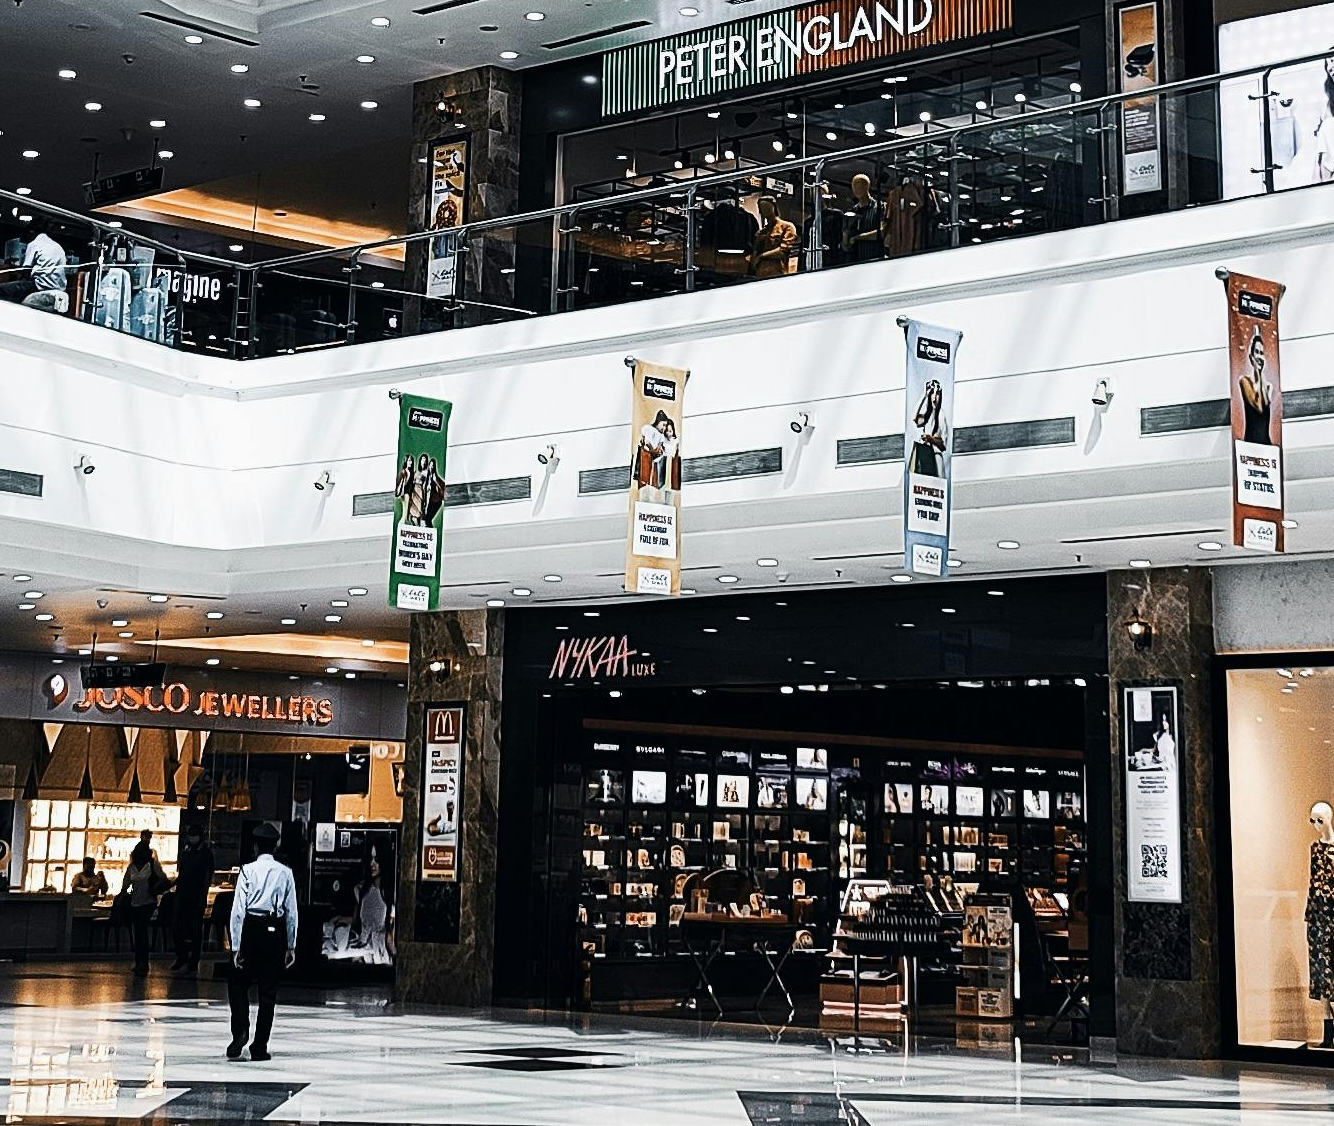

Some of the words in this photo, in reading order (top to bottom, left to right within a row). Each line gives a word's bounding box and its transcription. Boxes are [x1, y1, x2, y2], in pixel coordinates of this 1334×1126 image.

[659, 35, 748, 89] PETER
[549, 635, 637, 679] NYKAA
[631, 662, 656, 676] LUXE
[74, 682, 191, 714] JOSCO
[193, 690, 334, 724] JEWELLERS
